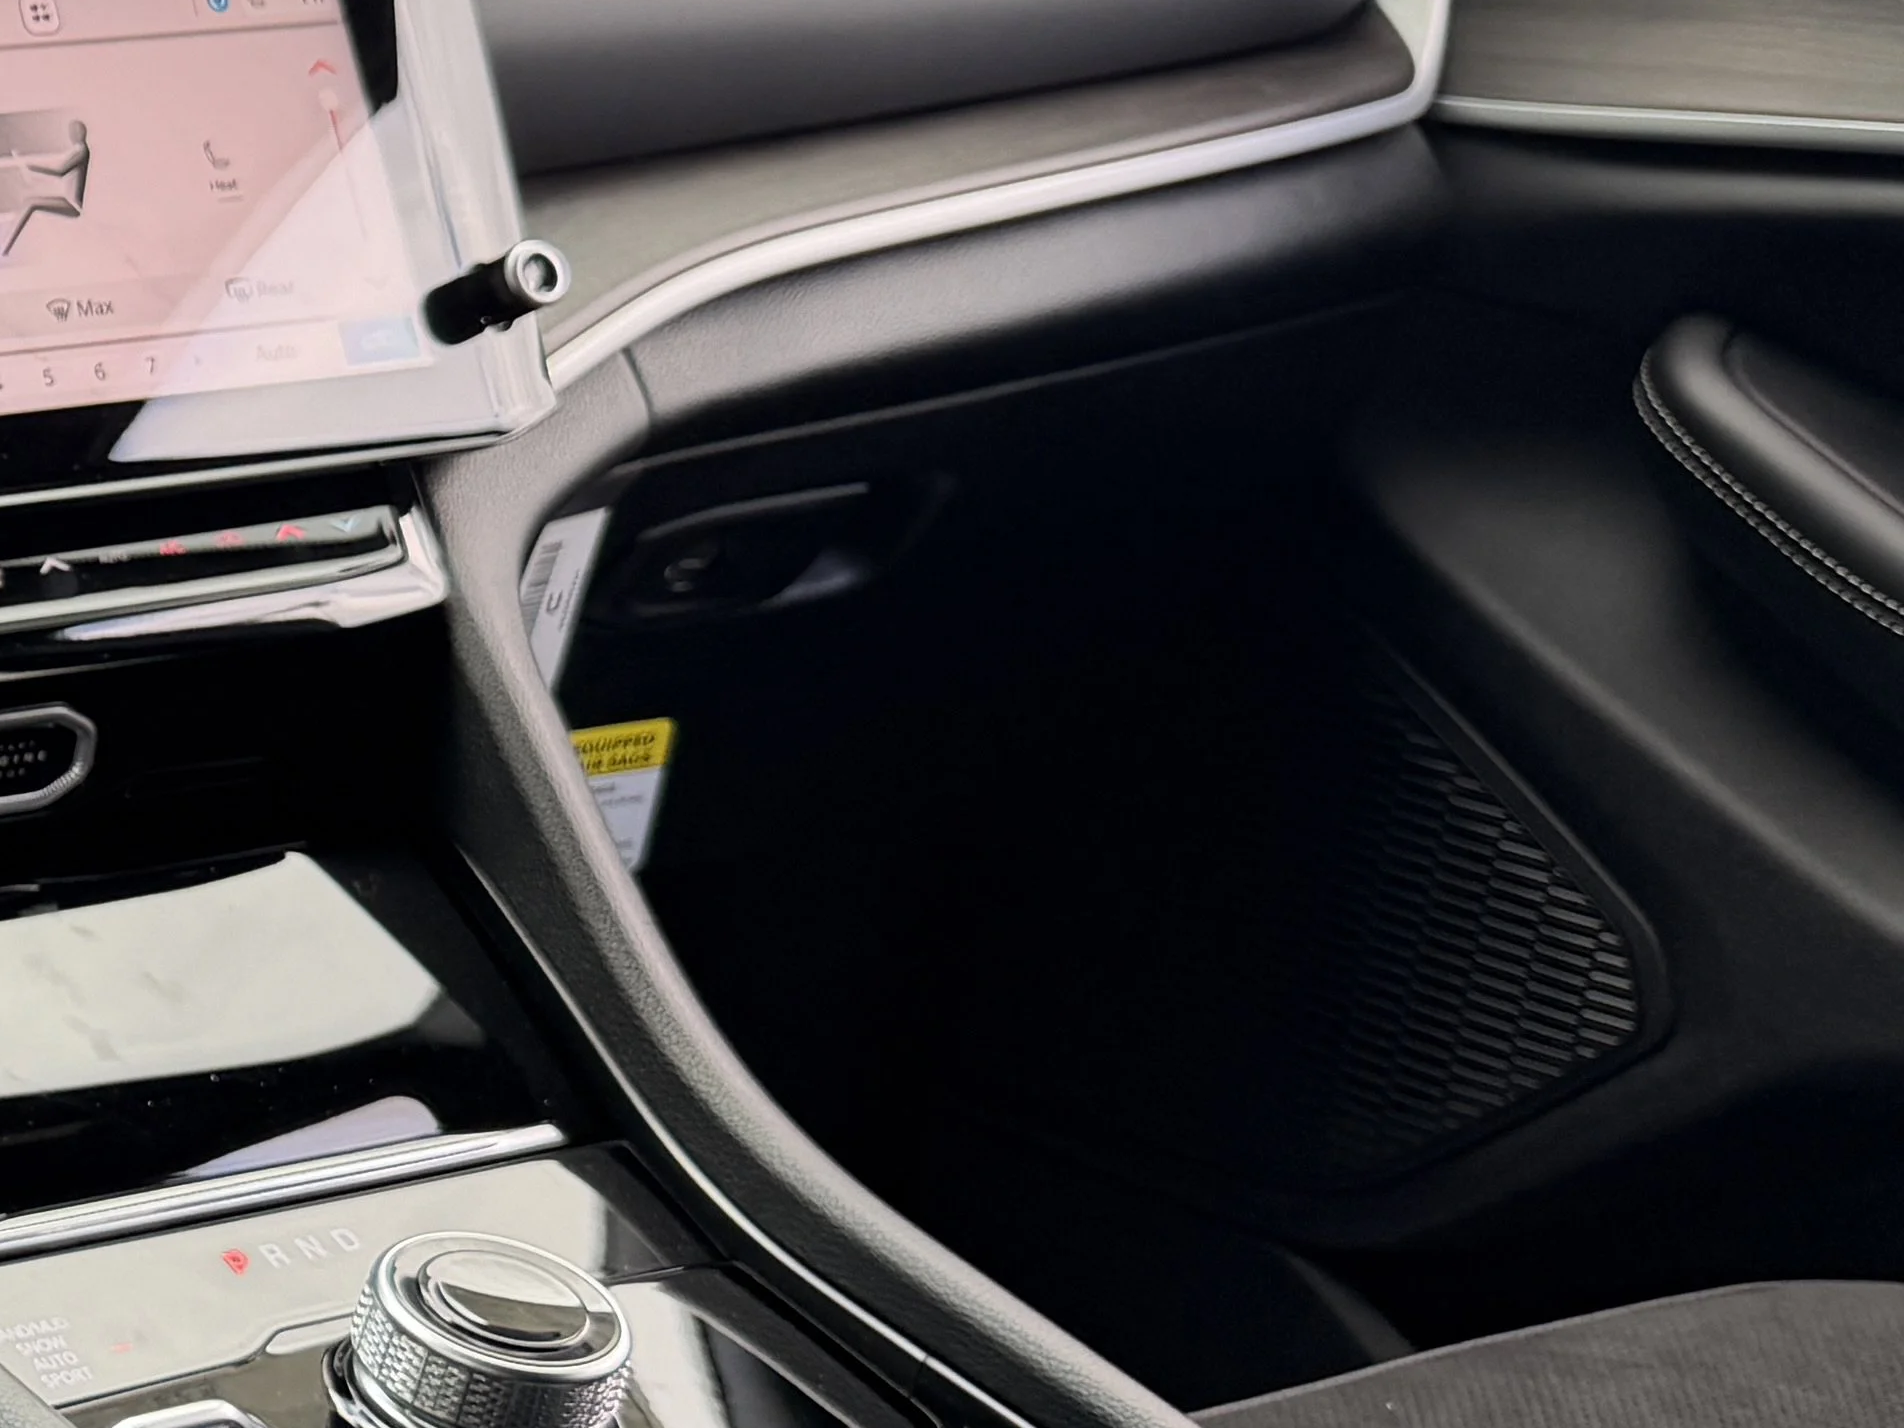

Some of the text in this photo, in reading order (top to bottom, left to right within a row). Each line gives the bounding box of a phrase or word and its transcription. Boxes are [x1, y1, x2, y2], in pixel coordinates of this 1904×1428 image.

[76, 299, 116, 318] Max
[42, 368, 55, 388] 5
[93, 362, 106, 382] 6
[145, 355, 157, 375] 7
[222, 1226, 361, 1275] P R N D
[32, 1350, 79, 1372] AUTO
[40, 1365, 93, 1389] SPORT
